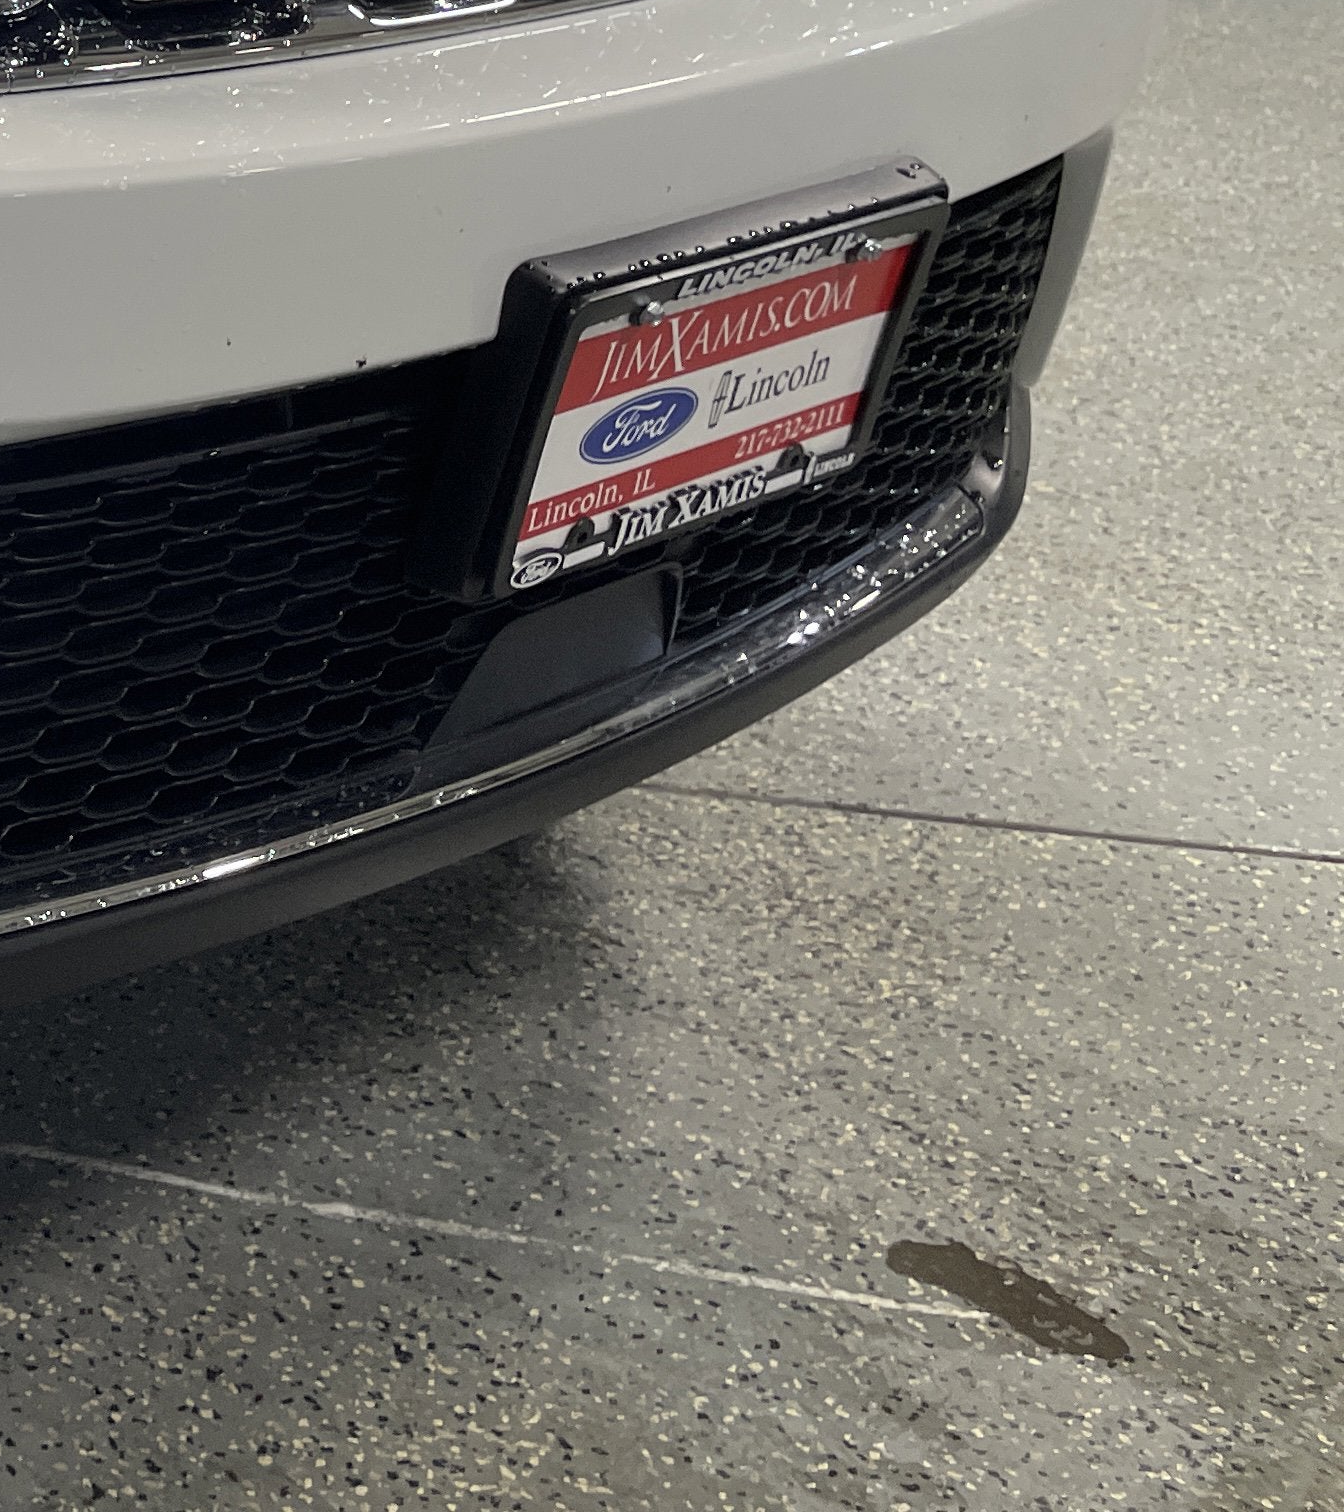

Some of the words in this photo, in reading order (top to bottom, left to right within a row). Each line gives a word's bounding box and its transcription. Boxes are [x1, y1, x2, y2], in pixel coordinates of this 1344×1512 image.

[589, 274, 858, 403] JIMXAMIS.COM
[724, 349, 831, 414] Lincoln
[602, 400, 677, 453] Ford
[734, 401, 845, 459] 217-732-2111
[527, 482, 624, 533] Lincoln,
[632, 468, 657, 496] IL
[607, 506, 669, 556] JIM
[667, 471, 767, 529] XAMIS
